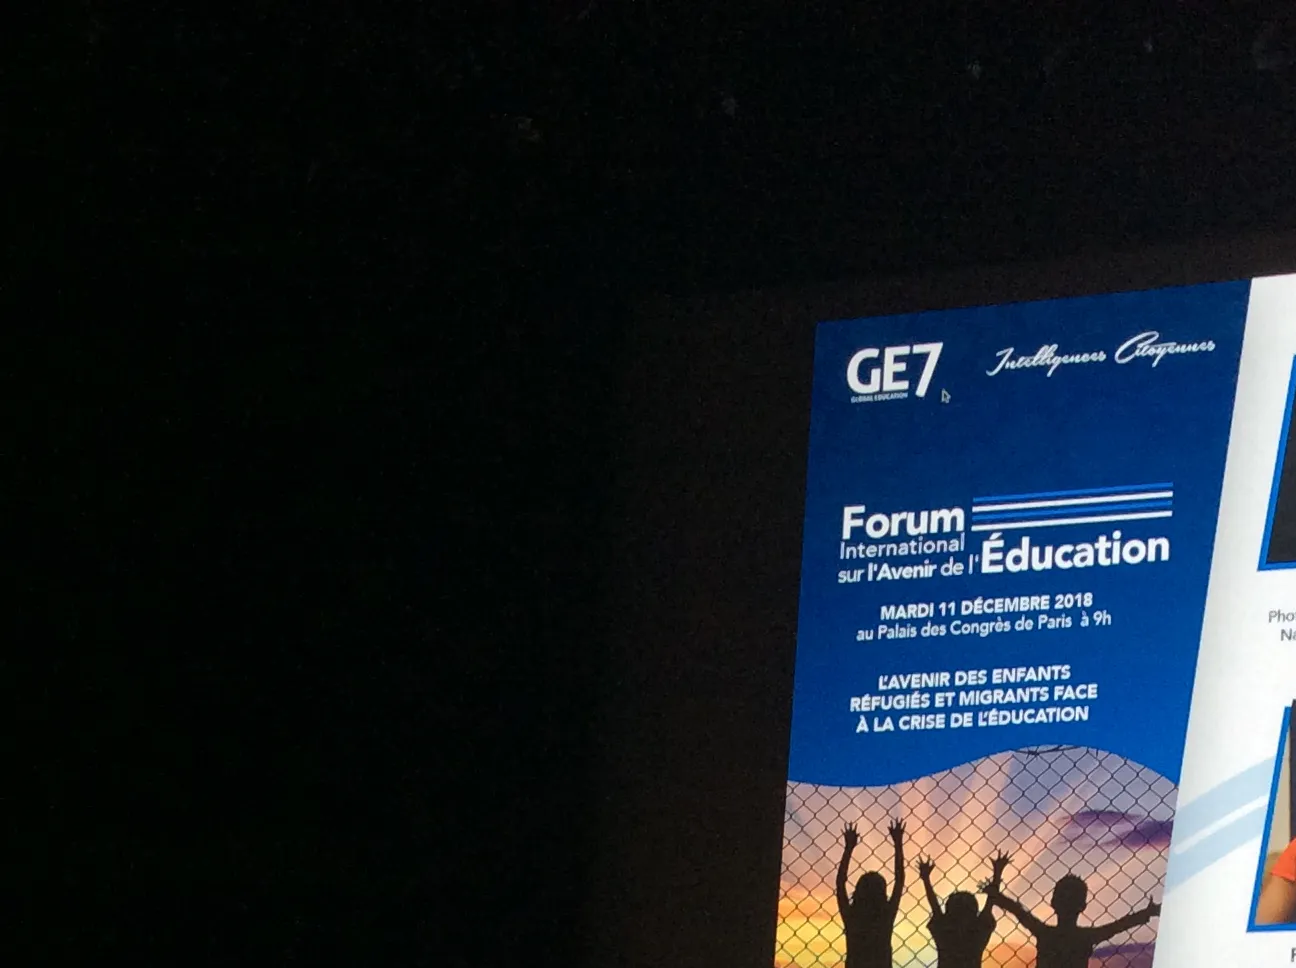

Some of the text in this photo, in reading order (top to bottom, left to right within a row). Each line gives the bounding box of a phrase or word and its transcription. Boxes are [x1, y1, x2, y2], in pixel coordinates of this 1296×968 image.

[1114, 331, 1215, 367] Citoyennes
[847, 342, 943, 397] GE7
[842, 505, 965, 540] Forum
[840, 532, 965, 559] International
[838, 569, 865, 583] sur
[868, 562, 937, 581] l'Avenir
[940, 556, 964, 576] de
[881, 592, 1093, 620] MARDI 11 DÉCEMBRE 2018
[856, 610, 1111, 641] au Palais des Congrès de Paris à 9h
[878, 664, 1071, 690] L'AVENIR DES ENFANTS
[850, 684, 1098, 712] RÉFUGIÉS ET MIGRANTS FACE
[856, 706, 1089, 733] À LA CRISE DE L'ÉDUCATION
